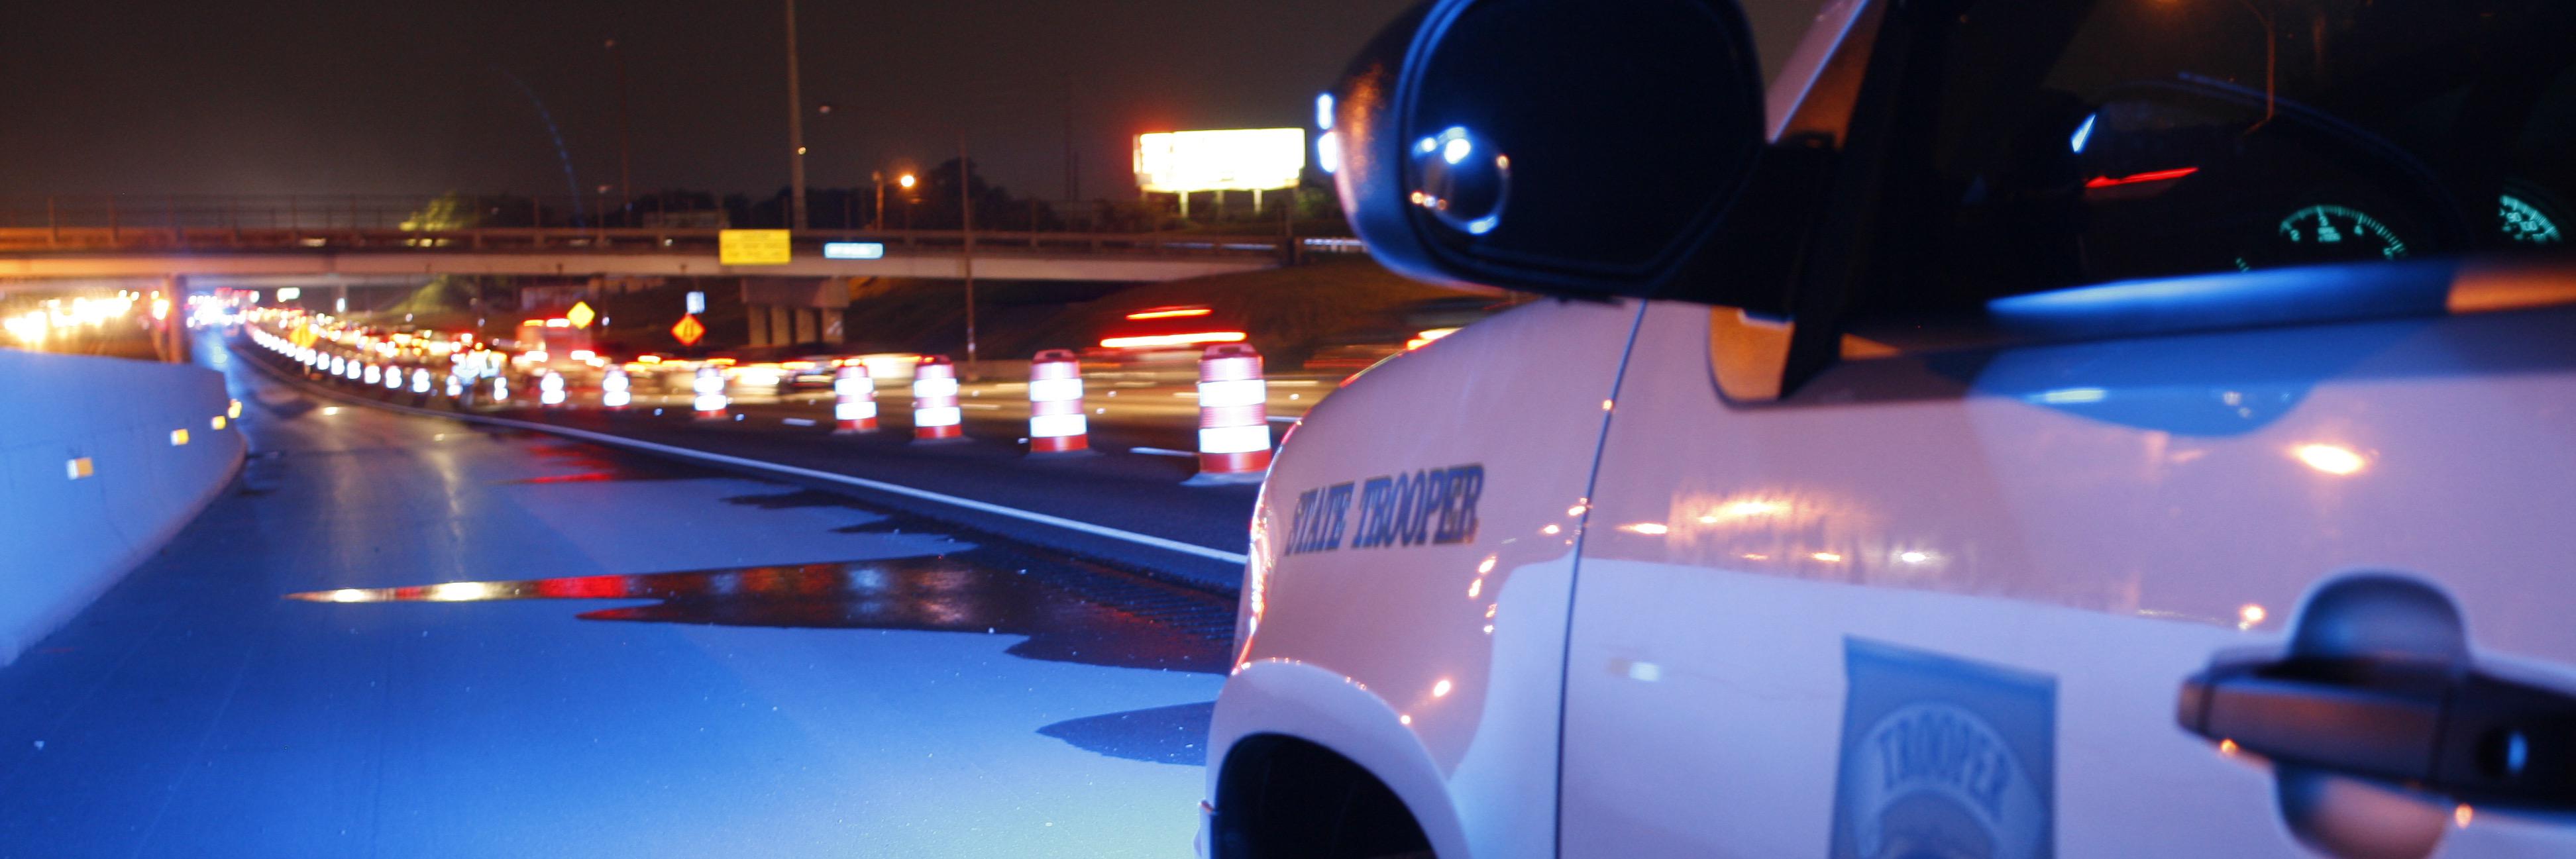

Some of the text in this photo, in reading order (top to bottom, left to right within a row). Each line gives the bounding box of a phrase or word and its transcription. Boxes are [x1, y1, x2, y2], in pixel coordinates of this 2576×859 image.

[2290, 229, 2300, 242] 2
[1285, 464, 1484, 556] STATE TROOPER
[1878, 712, 2010, 823] TROOPER
